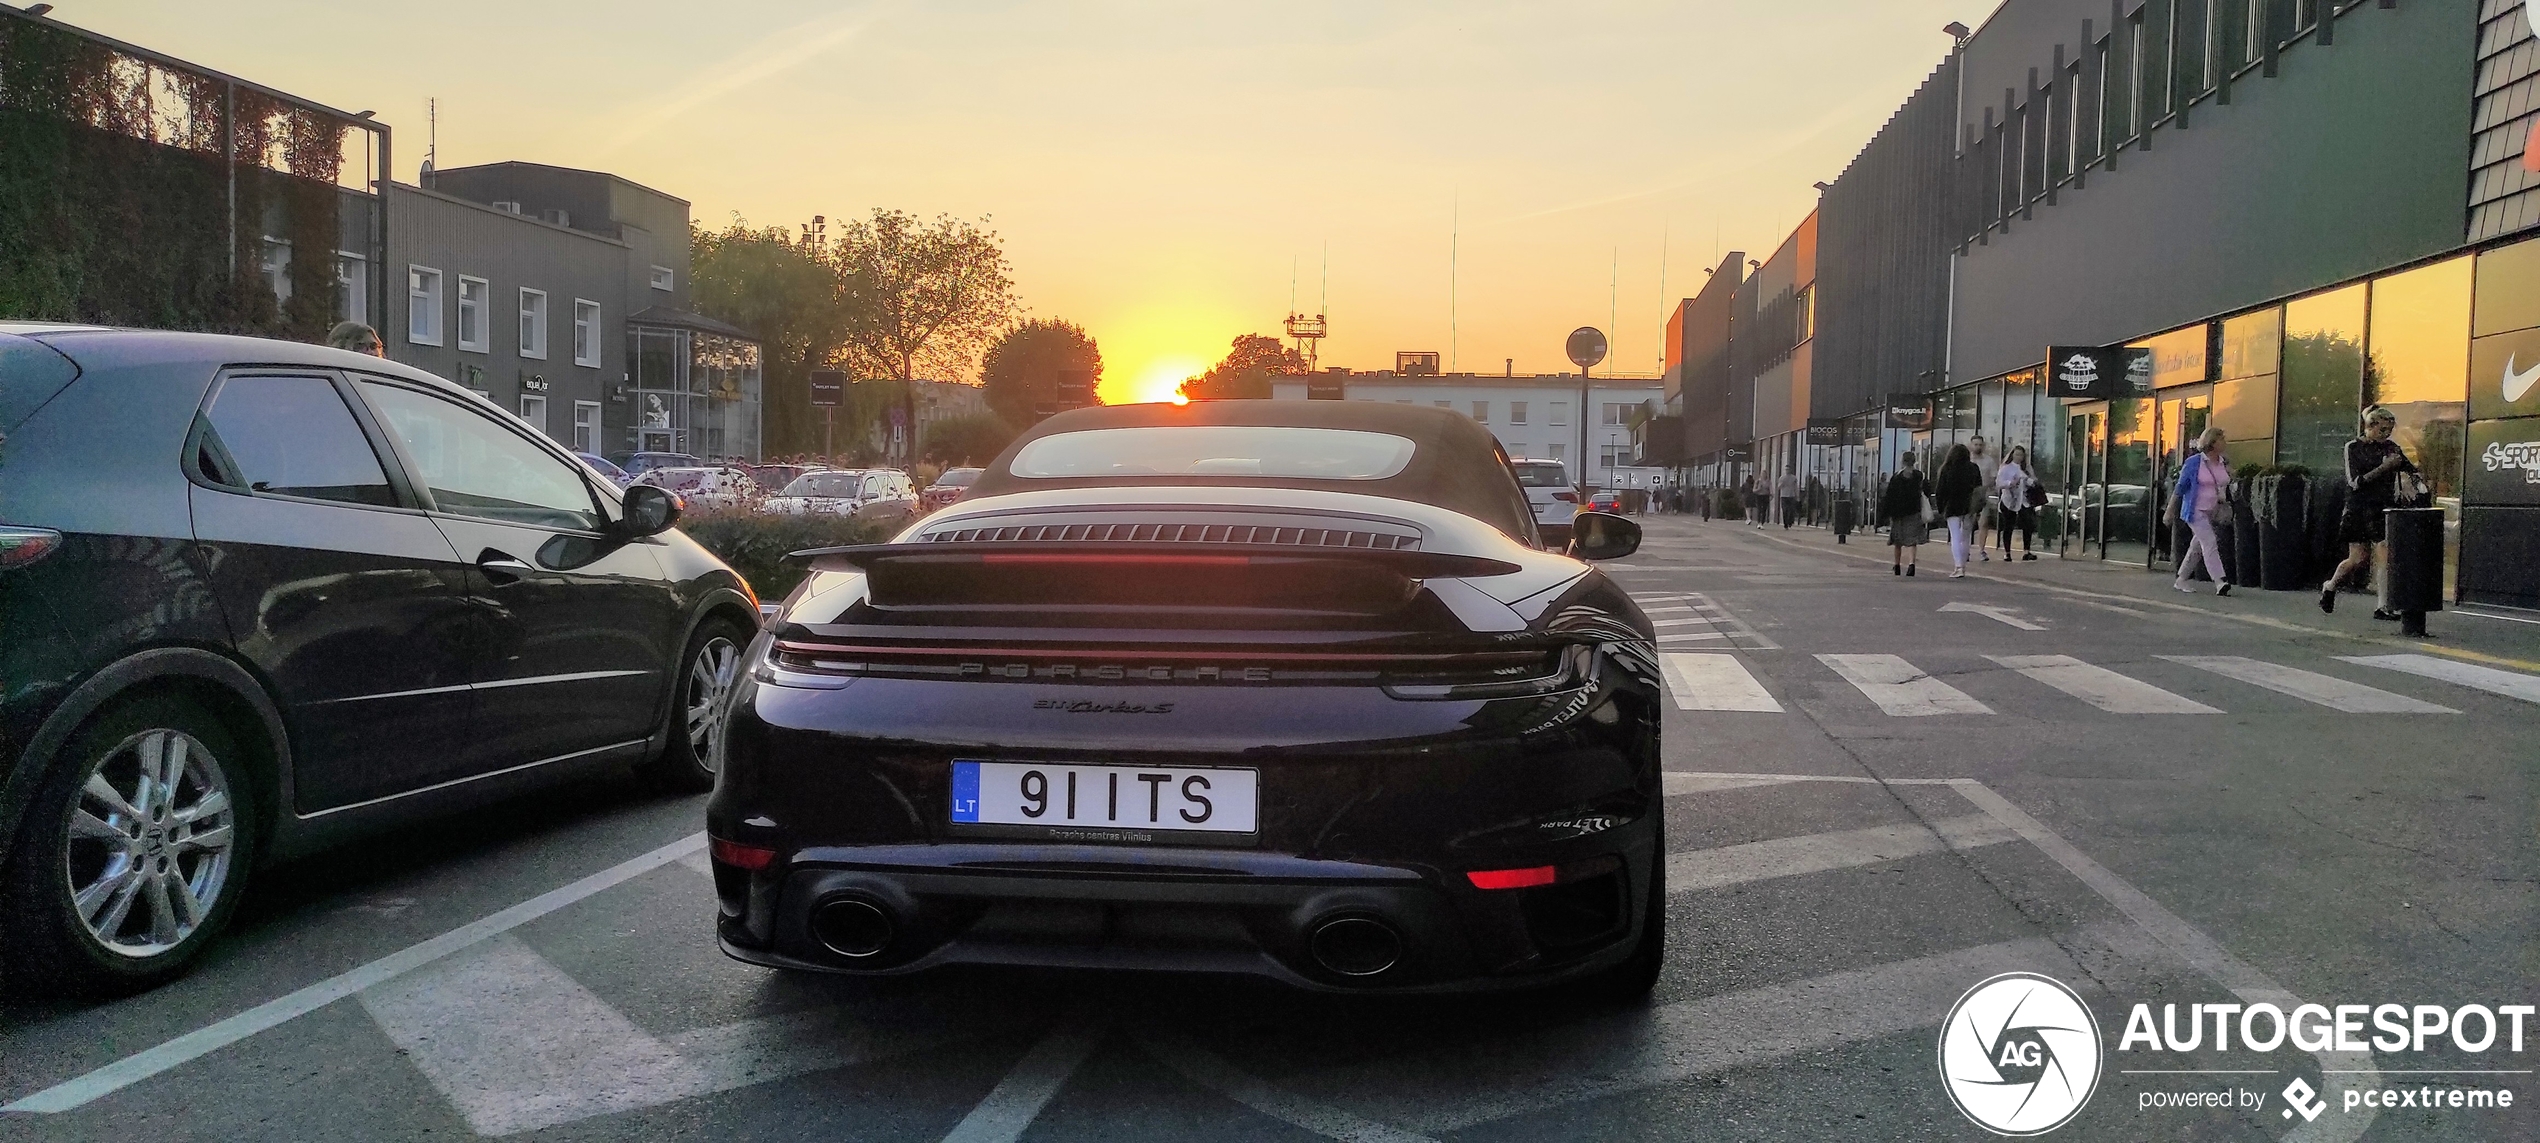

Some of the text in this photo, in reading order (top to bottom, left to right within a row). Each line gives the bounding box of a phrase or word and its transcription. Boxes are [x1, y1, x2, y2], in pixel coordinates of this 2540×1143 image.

[959, 663, 1270, 681] PORSCHE
[955, 799, 976, 813] LT
[1050, 829, 1152, 842] Porsche centras Vilnius
